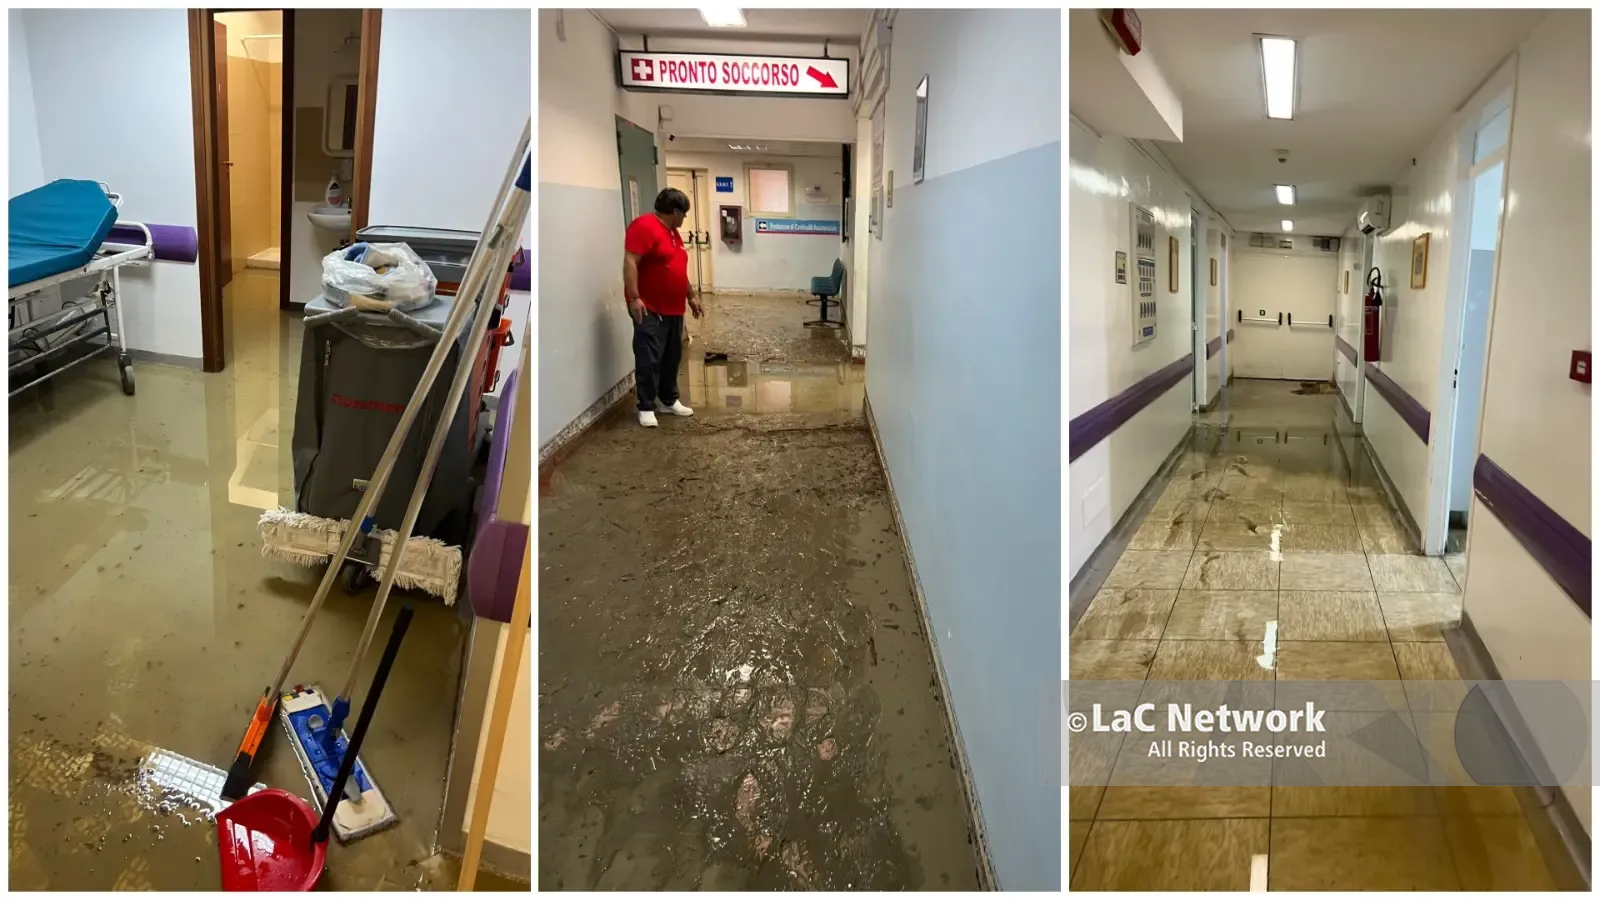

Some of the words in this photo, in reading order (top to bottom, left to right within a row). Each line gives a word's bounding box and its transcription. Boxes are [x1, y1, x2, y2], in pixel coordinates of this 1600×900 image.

[659, 60, 717, 84] PRONTO
[722, 61, 800, 87] SOCCORSO
[332, 393, 406, 413] Dussman
